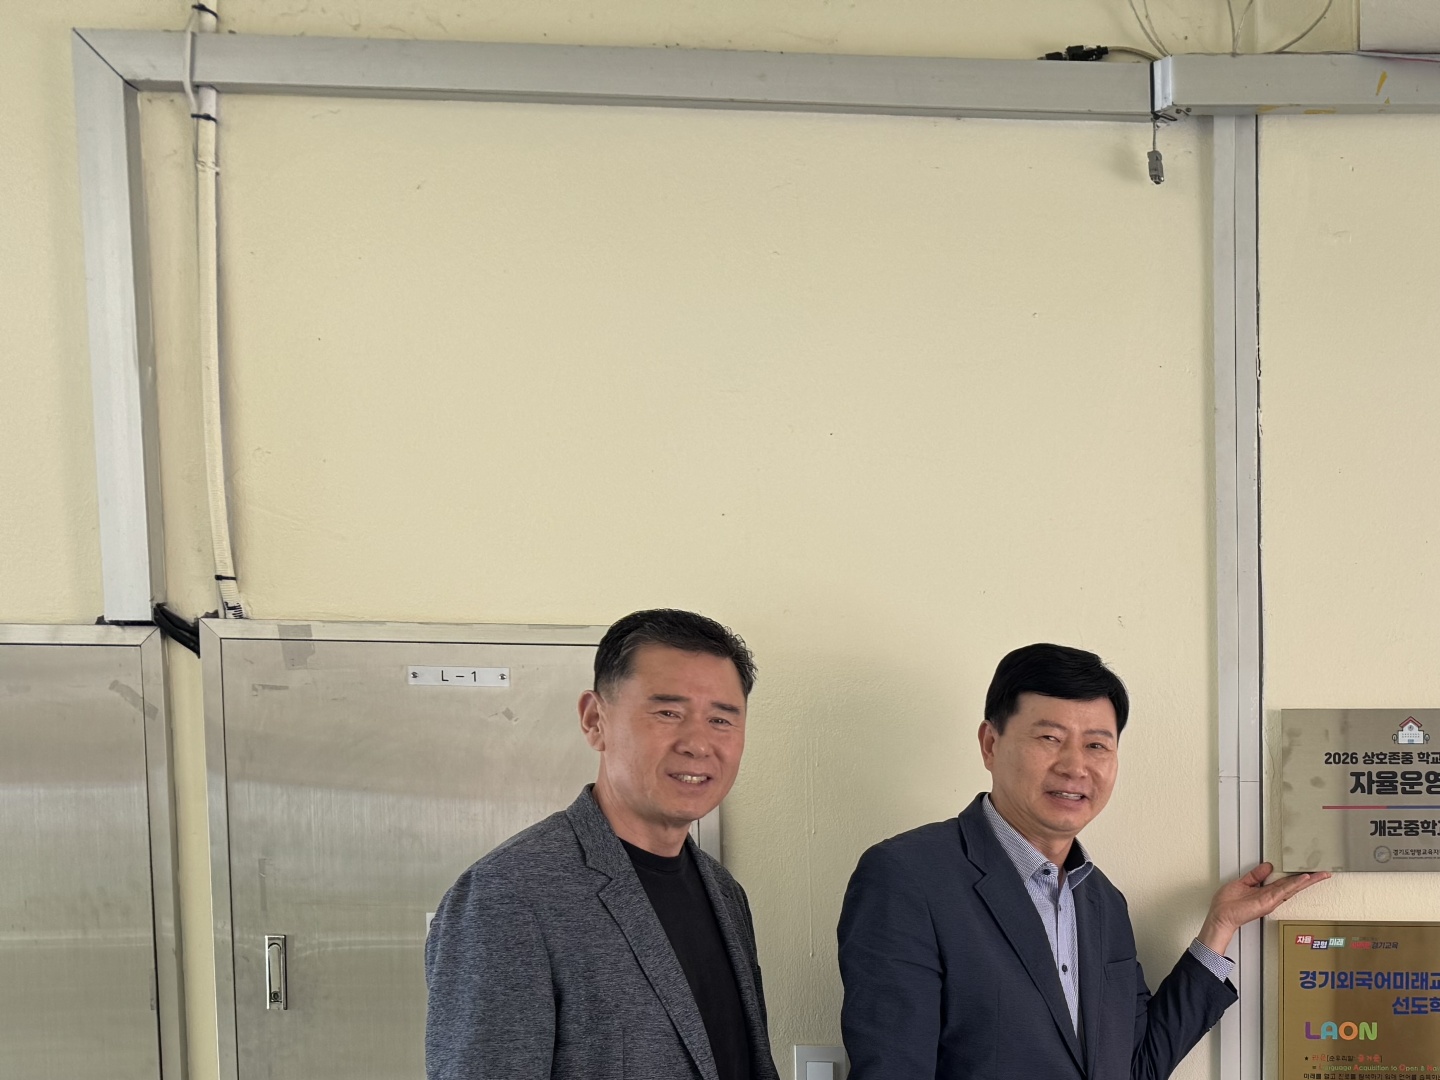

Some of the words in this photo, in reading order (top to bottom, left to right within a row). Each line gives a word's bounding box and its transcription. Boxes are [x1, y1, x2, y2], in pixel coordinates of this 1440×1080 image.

[1324, 752, 1358, 764] 2026
[1362, 752, 1413, 765] 상호존중
[1305, 1021, 1378, 1040] LAON
